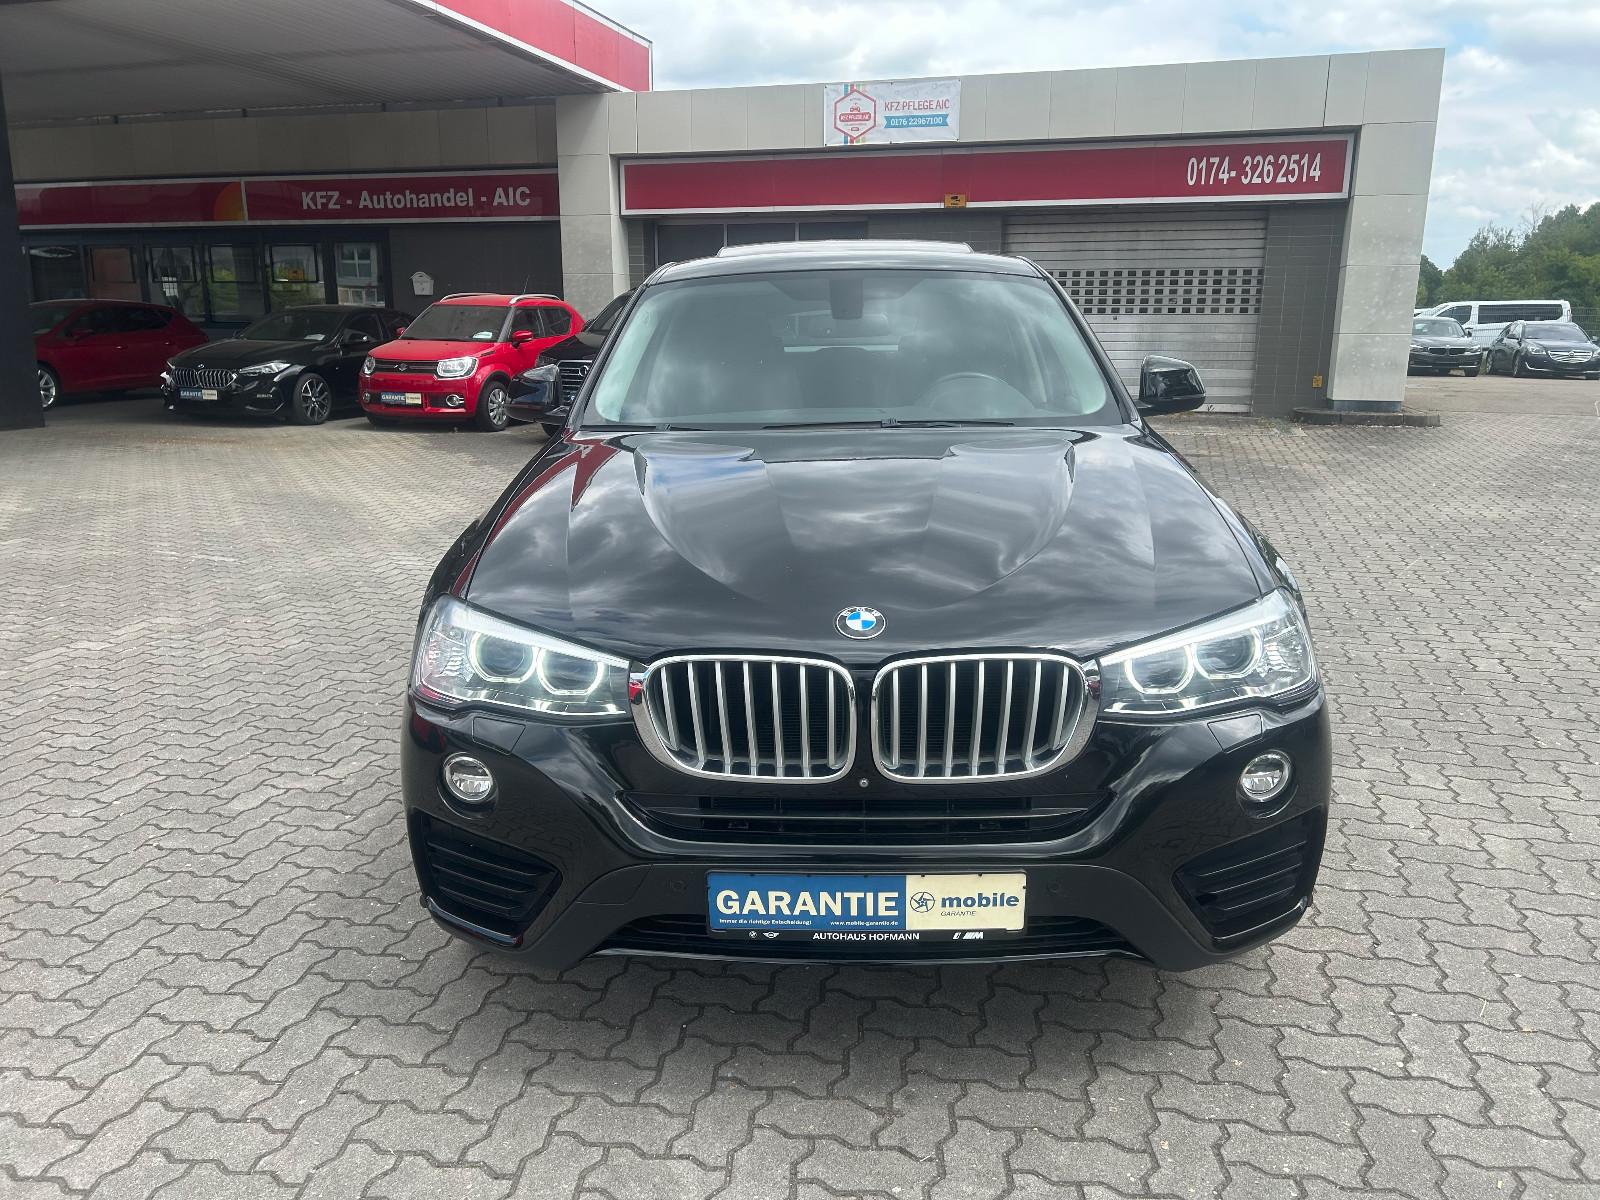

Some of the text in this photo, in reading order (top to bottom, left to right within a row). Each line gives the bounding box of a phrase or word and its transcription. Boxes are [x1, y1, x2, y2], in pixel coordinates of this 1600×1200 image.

[884, 98, 950, 111] KFZ PFLEGE AIC
[890, 116, 943, 126] 0176 22967100
[301, 191, 341, 209] KFZ
[358, 188, 474, 209] Autohandel
[493, 186, 531, 207] AIC
[716, 889, 899, 916] GARANTIE
[940, 893, 1020, 908] mobile
[812, 932, 920, 941] AUTOHAUS HOFMANN
